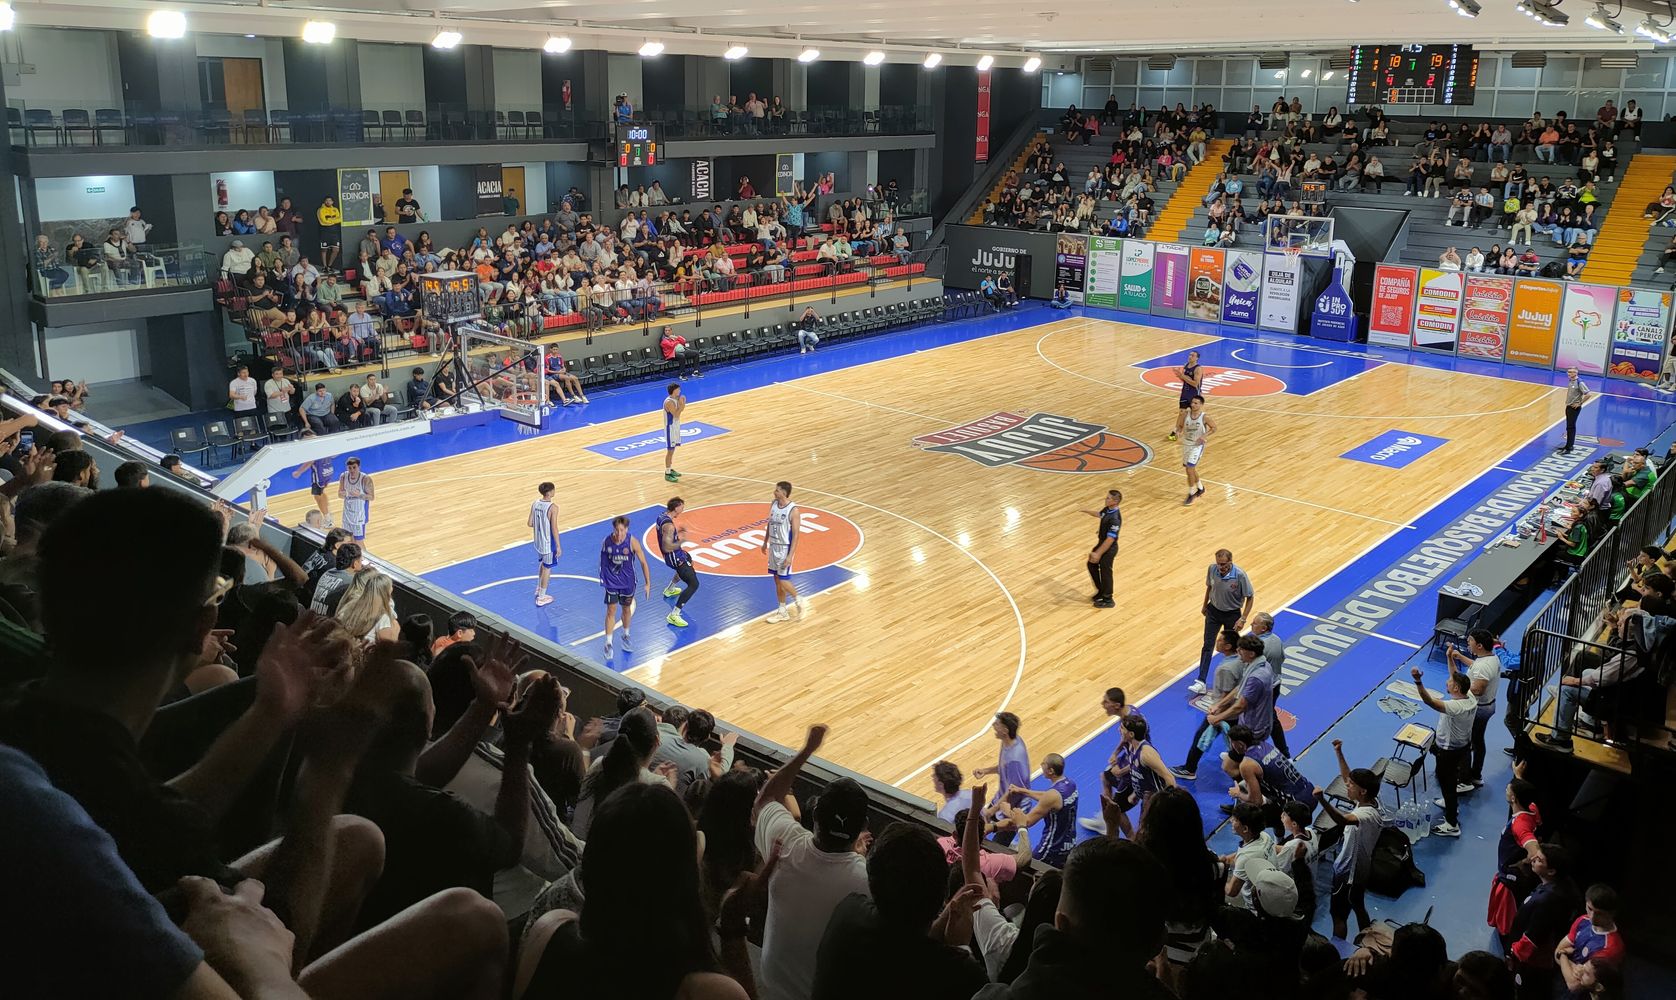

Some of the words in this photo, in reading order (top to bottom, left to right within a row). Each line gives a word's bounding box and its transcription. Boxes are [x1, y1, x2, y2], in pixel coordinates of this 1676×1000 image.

[1390, 55, 1402, 68] 18
[1431, 54, 1443, 67] 19
[1387, 76, 1394, 86] 4
[1426, 75, 1435, 86] 2
[627, 129, 648, 140] 10:00
[625, 143, 631, 154] 0
[650, 142, 656, 153] 0
[621, 155, 627, 166] 0
[648, 154, 654, 165] 0
[696, 160, 709, 199] ACACIA
[477, 180, 502, 194] ACACIA
[342, 191, 369, 200] EDINOR
[992, 246, 1019, 254] GOBIERNO
[1380, 276, 1410, 287] COMPAÑÍA
[1387, 286, 1410, 296] SEGUROS
[1424, 288, 1457, 298] COMODIN
[1331, 302, 1346, 310] PRO
[1420, 319, 1453, 330] COMODIN
[1639, 331, 1663, 340] PERICO
[933, 414, 1019, 443] BASQUET
[952, 417, 1091, 462] JUJUY
[1474, 499, 1525, 521] DE
[701, 528, 738, 544] gente
[1358, 516, 1508, 605] BASQUETBOL
[1326, 599, 1395, 632] DE
